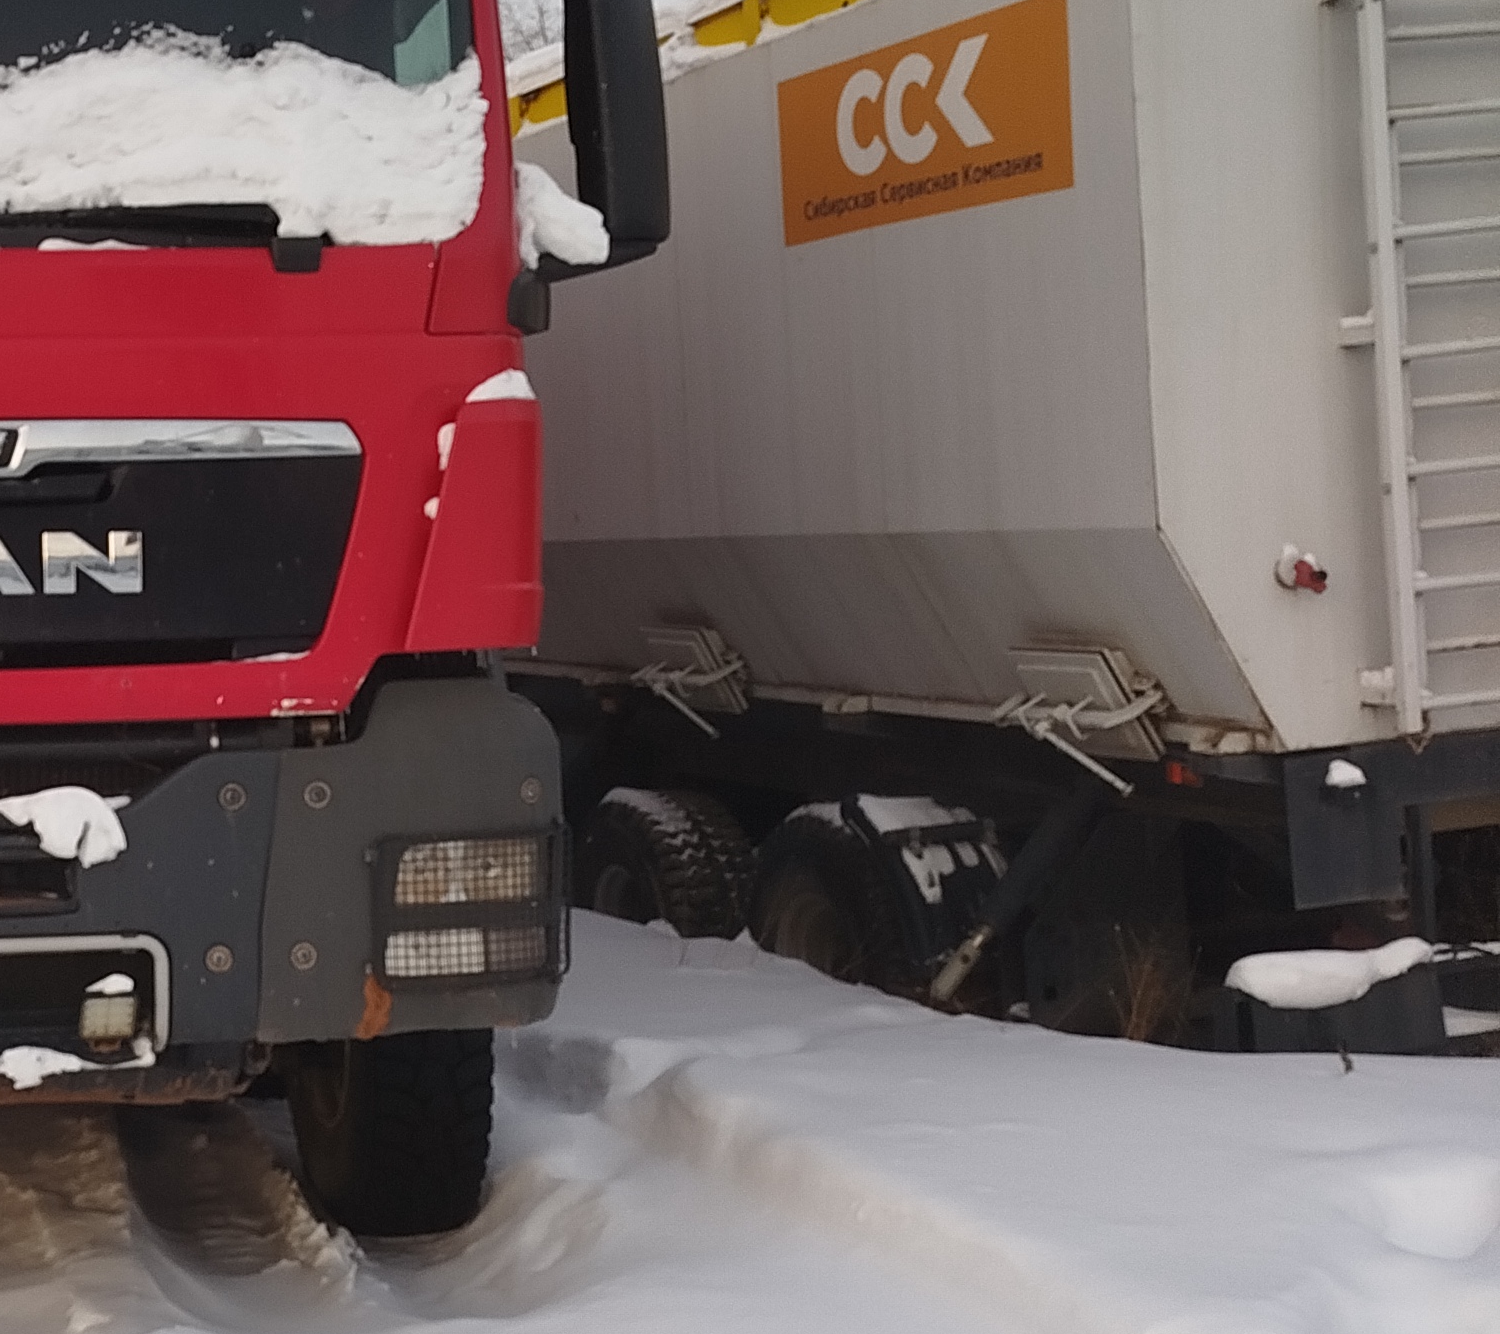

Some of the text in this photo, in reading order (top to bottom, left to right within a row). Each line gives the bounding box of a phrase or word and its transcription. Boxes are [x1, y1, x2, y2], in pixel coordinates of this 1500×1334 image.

[836, 33, 994, 176] ССК
[803, 151, 1043, 221] Сибирская Сервисная Компания
